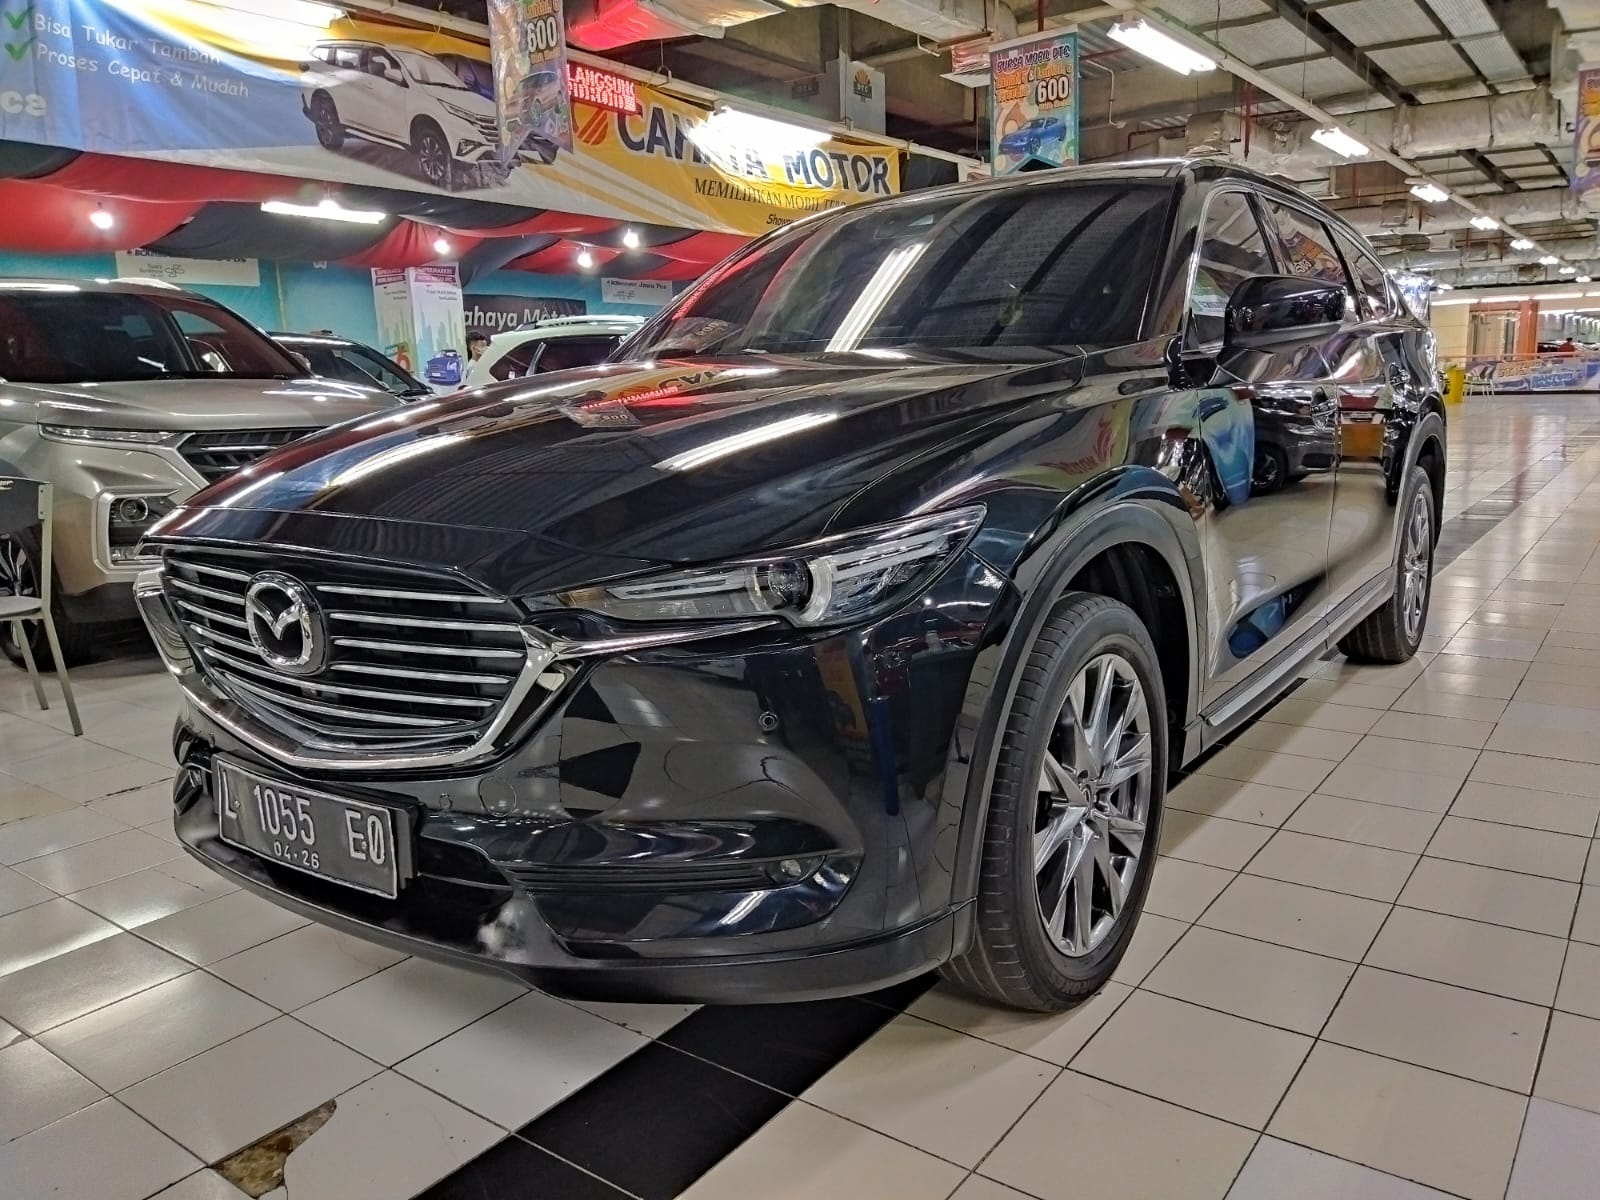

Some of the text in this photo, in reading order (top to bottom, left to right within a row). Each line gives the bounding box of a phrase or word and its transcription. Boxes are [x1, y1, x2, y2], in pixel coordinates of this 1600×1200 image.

[34, 13, 72, 38] Bisa
[81, 24, 139, 51] Tukar
[527, 16, 558, 53] 600
[36, 42, 249, 97] Proses Cepat & Mudah
[997, 45, 1070, 73] BURSA MOBIL DTC
[1037, 75, 1070, 103] 600
[782, 149, 891, 195] MOTOR
[784, 193, 820, 211] MOBIL
[222, 771, 238, 820] L
[253, 784, 316, 846] 1055
